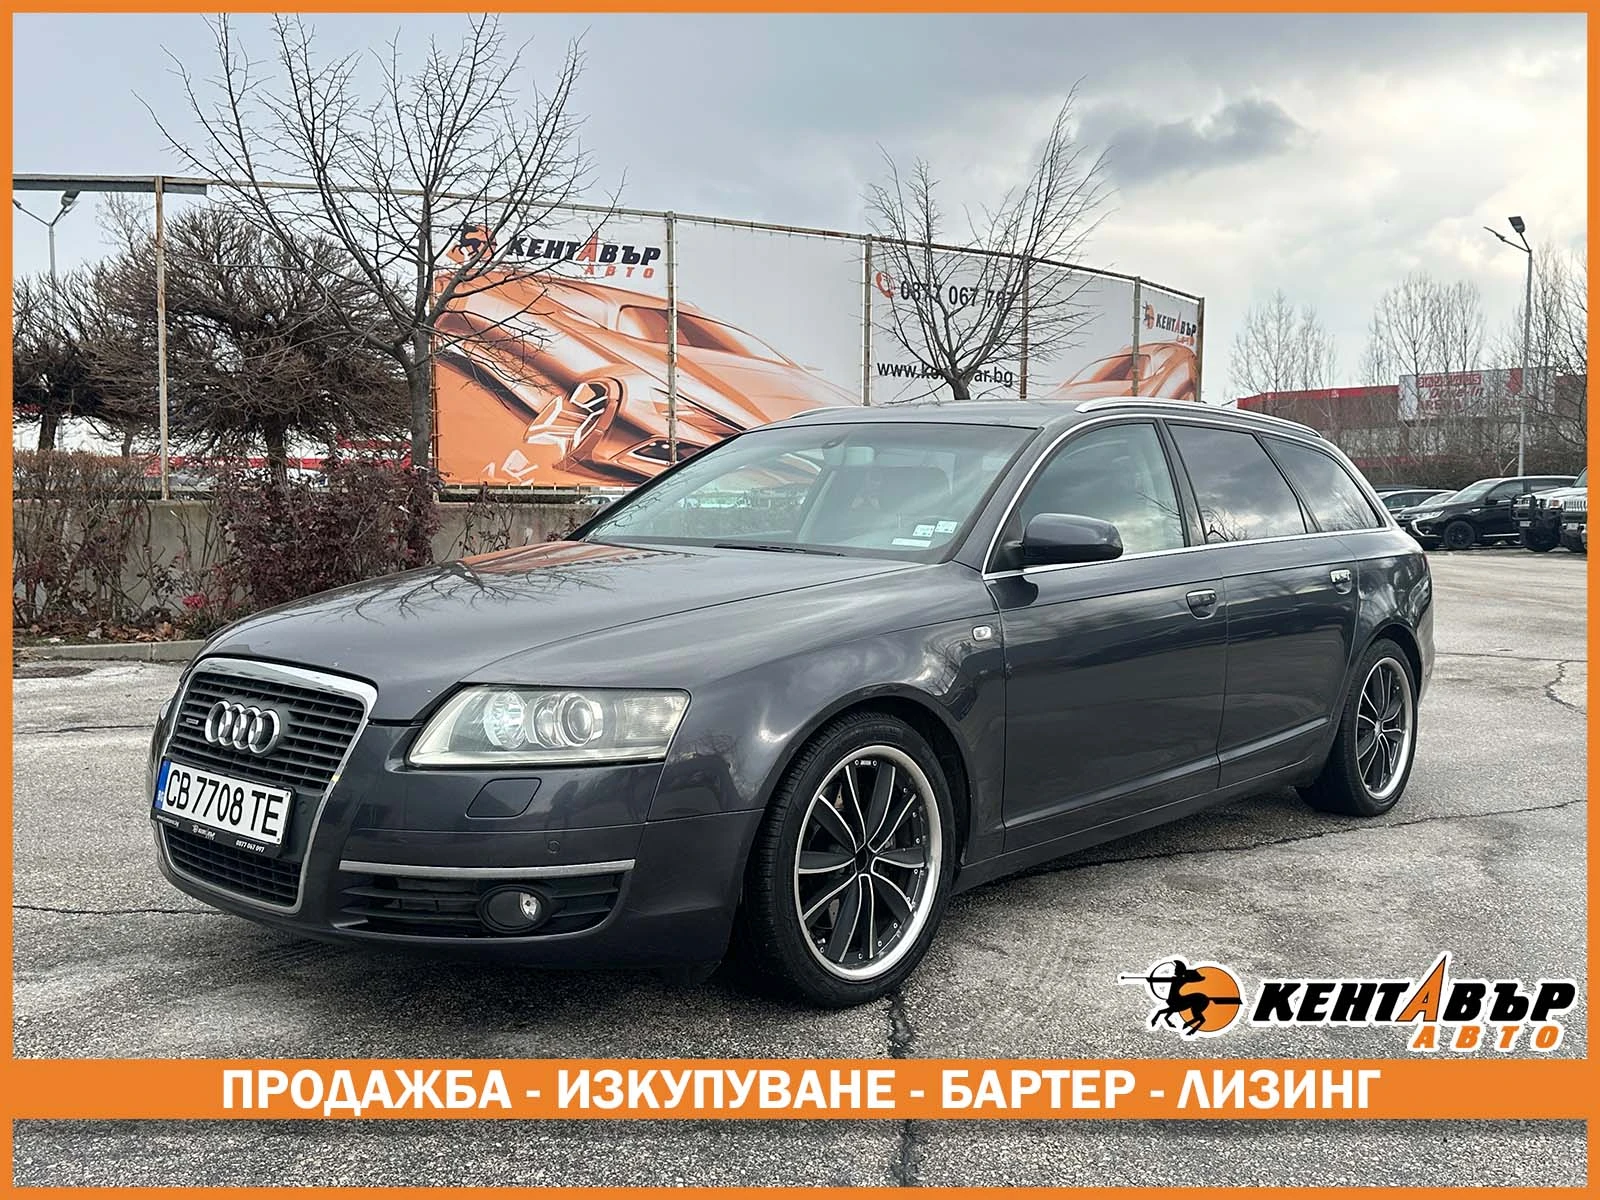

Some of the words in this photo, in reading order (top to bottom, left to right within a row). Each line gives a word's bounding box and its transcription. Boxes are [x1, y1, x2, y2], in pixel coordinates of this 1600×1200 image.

[507, 231, 661, 266] КЕНТАВЪР
[583, 264, 655, 279] АВТО
[948, 285, 978, 307] 067
[1155, 311, 1198, 337] КЕНТАВЪР
[876, 361, 1013, 388] www.kear.bg
[191, 776, 245, 826] 7708
